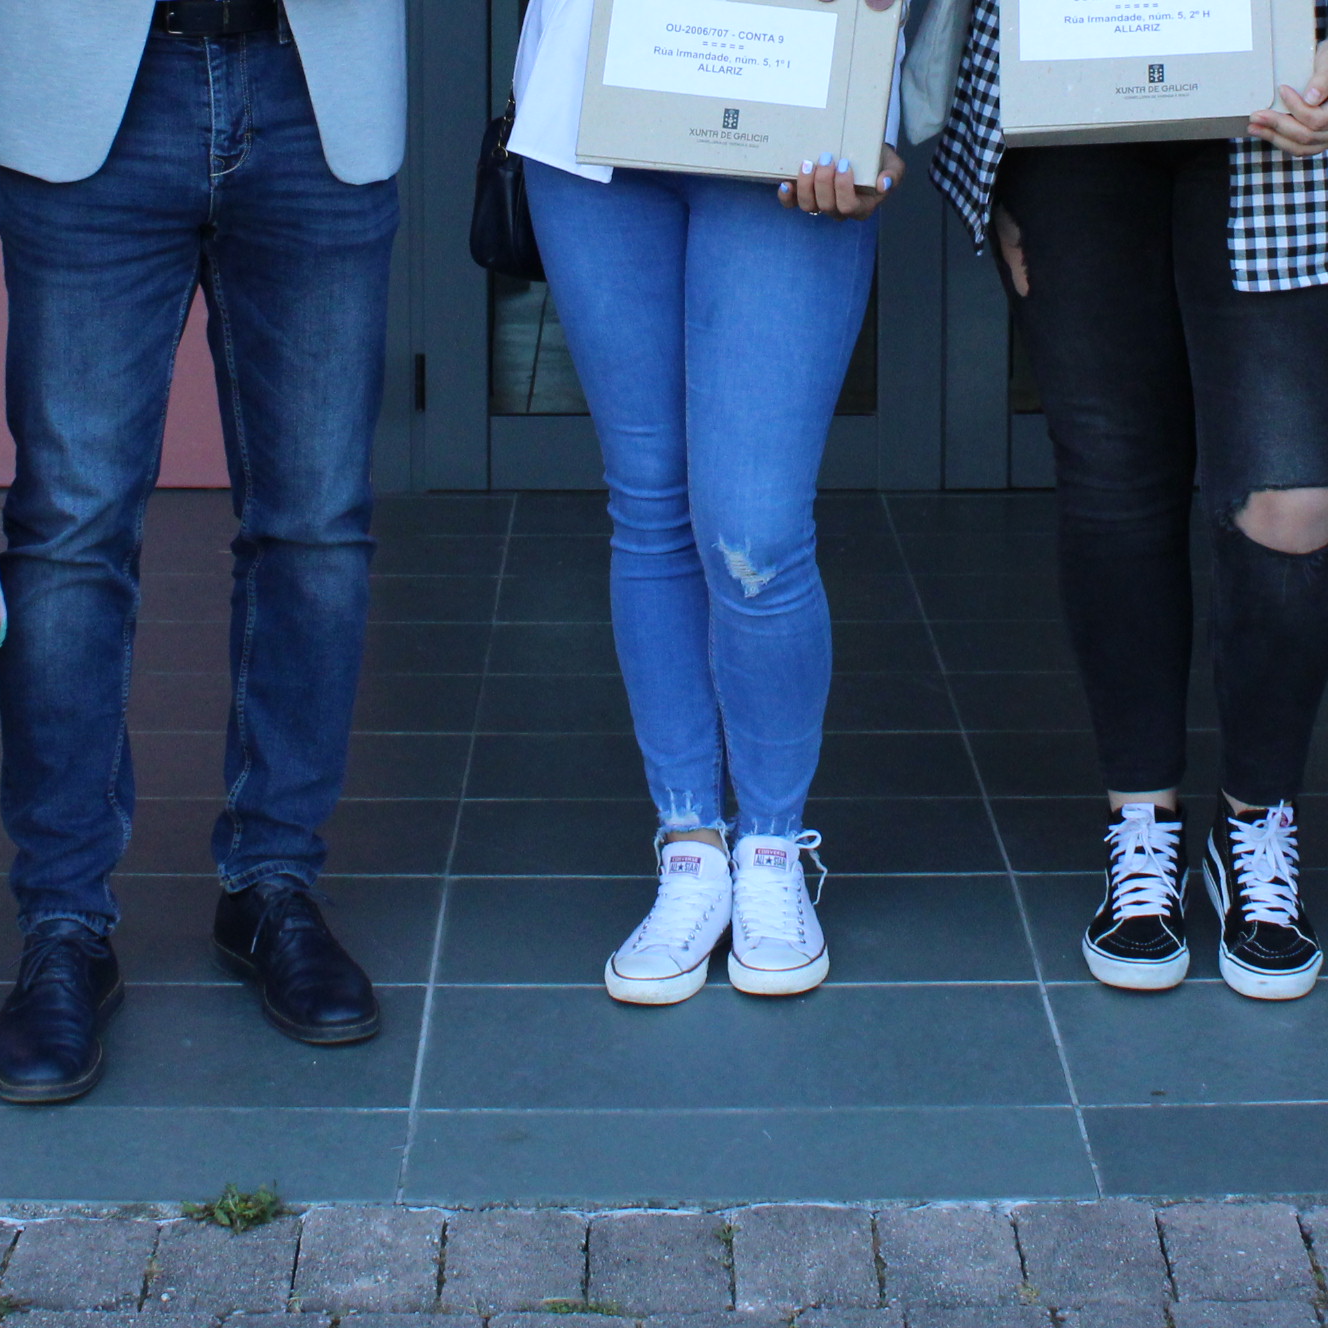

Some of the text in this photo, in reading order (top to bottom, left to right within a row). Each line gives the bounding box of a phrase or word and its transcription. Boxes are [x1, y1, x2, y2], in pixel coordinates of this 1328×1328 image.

[1064, 15, 1085, 24] Rúa
[1087, 13, 1146, 23] Irmandade,
[1203, 10, 1211, 18] H
[665, 23, 729, 38] OU-2006/707
[738, 31, 775, 43] CONTA
[778, 35, 785, 44] 9
[1114, 23, 1161, 33] ALLARIZ
[653, 46, 673, 56] Rúa
[676, 48, 732, 63] Irmandade,
[697, 63, 744, 76] ALLARIZ
[1115, 83, 1199, 95] XUNTA DE GALICIA
[688, 128, 769, 143] XUNTA DE GALICIA
